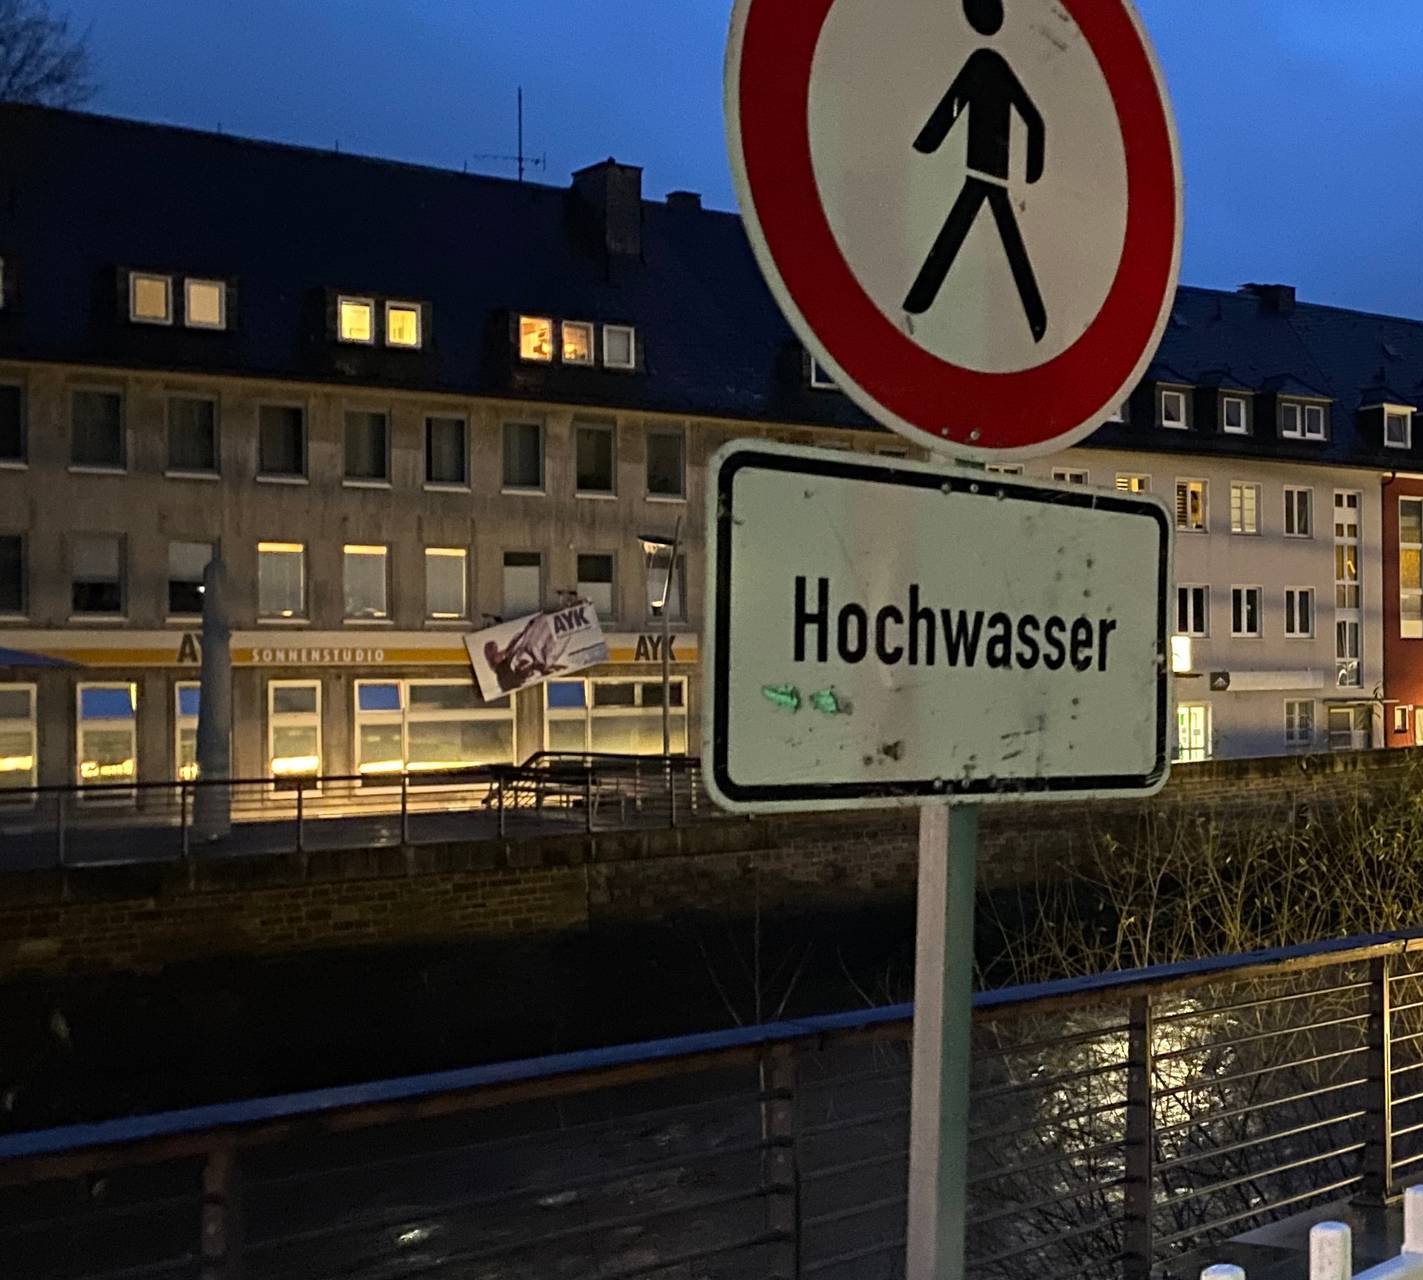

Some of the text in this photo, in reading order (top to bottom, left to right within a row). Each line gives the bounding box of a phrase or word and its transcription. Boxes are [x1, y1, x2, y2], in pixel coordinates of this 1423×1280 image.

[553, 606, 590, 634] AYK
[794, 575, 1117, 671] Hochwasser
[252, 649, 385, 662] SONNENSTUDIO
